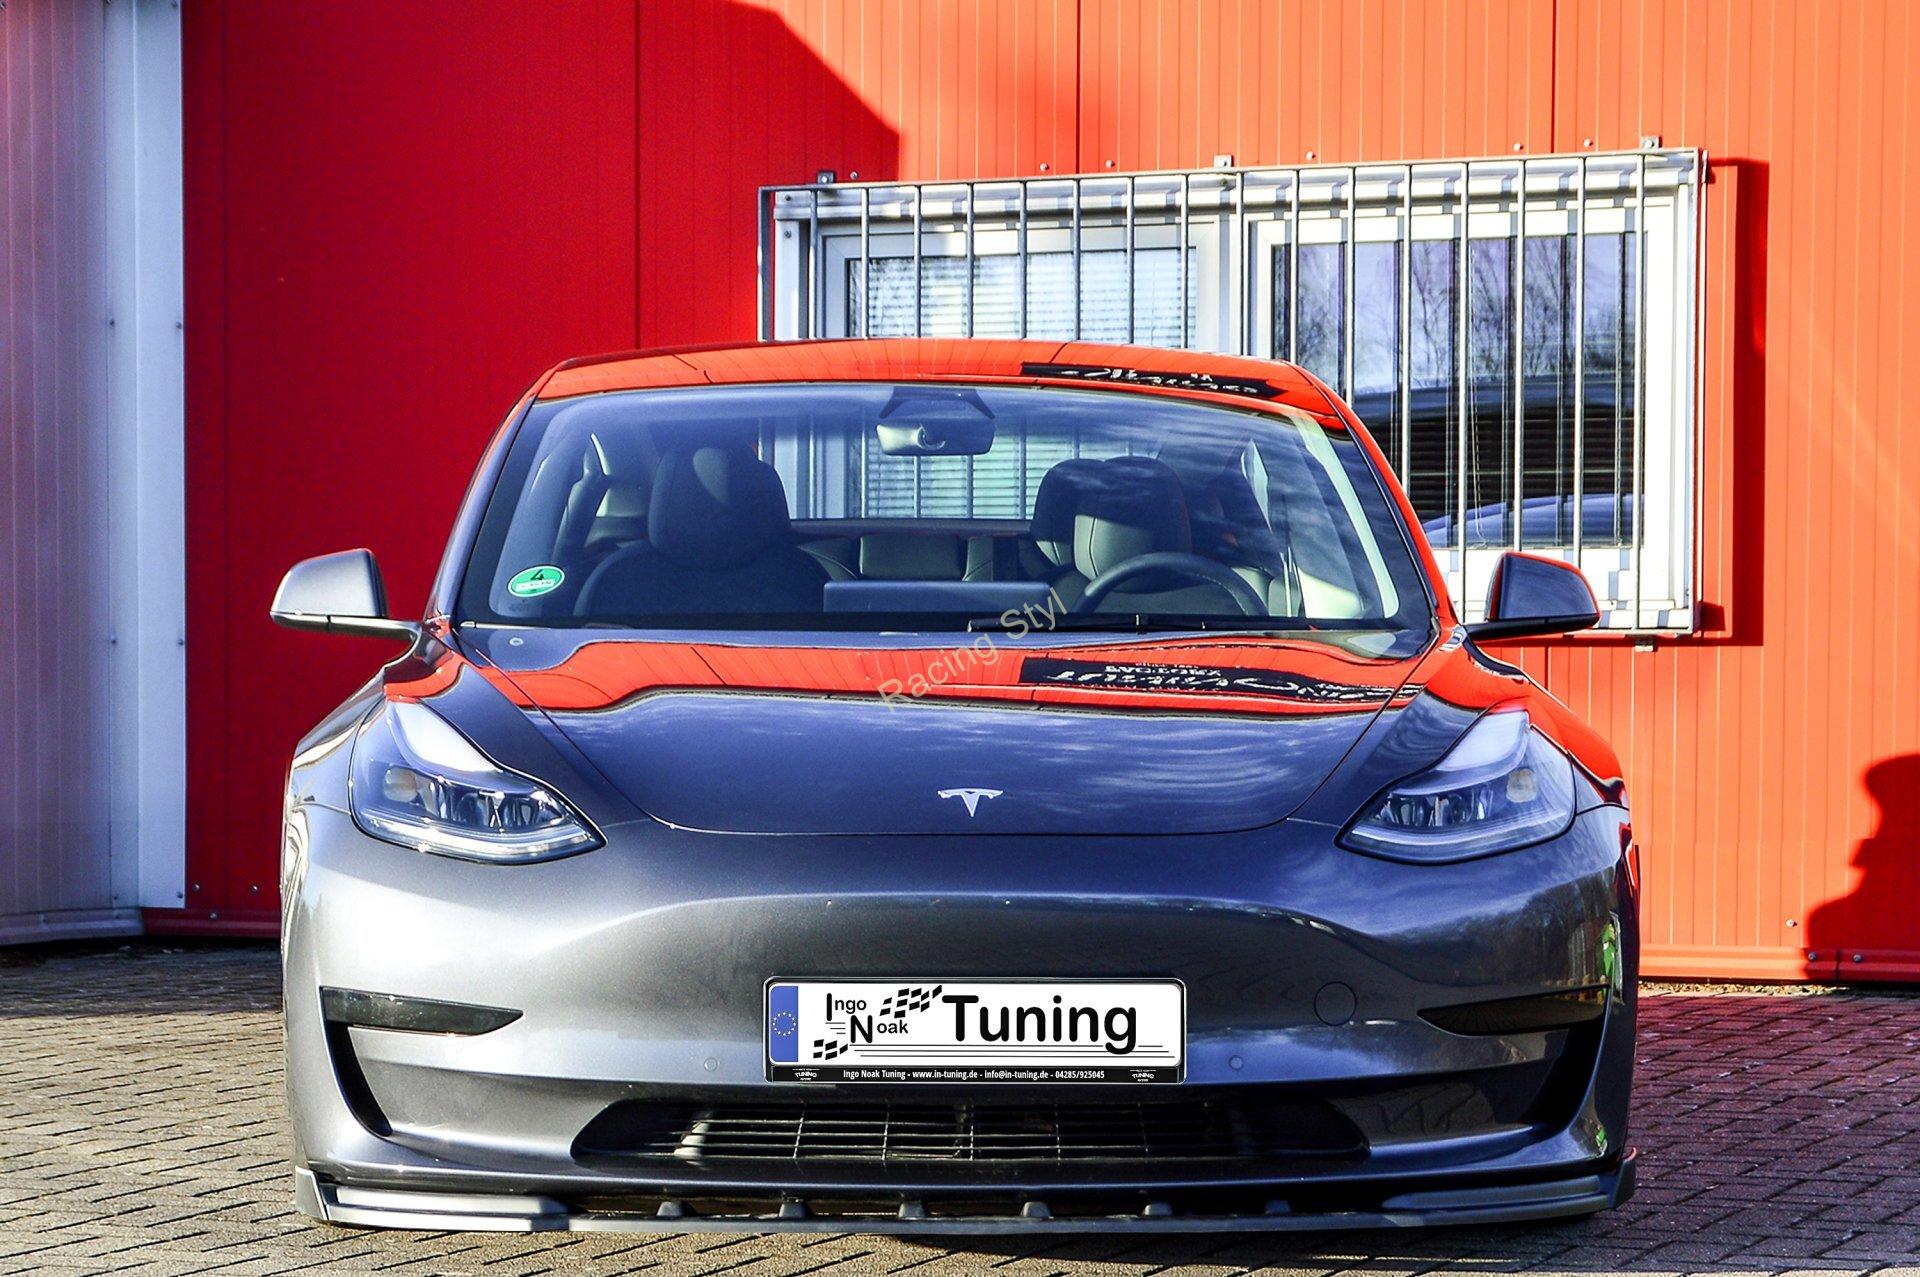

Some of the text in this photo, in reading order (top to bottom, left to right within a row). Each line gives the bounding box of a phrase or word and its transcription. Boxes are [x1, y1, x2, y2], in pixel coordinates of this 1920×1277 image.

[530, 568, 544, 580] 4
[826, 992, 867, 1021] Ingo
[849, 1014, 909, 1043] Noak
[941, 994, 1137, 1055] Tuning
[843, 1069, 859, 1080] Ingo
[861, 1069, 880, 1078] Noak
[882, 1069, 906, 1080] Tuning
[912, 1069, 978, 1080] www.in-tuning.de
[984, 1069, 1048, 1081] info@in-tuning.de
[1055, 1070, 1104, 1079] 04285/925045
